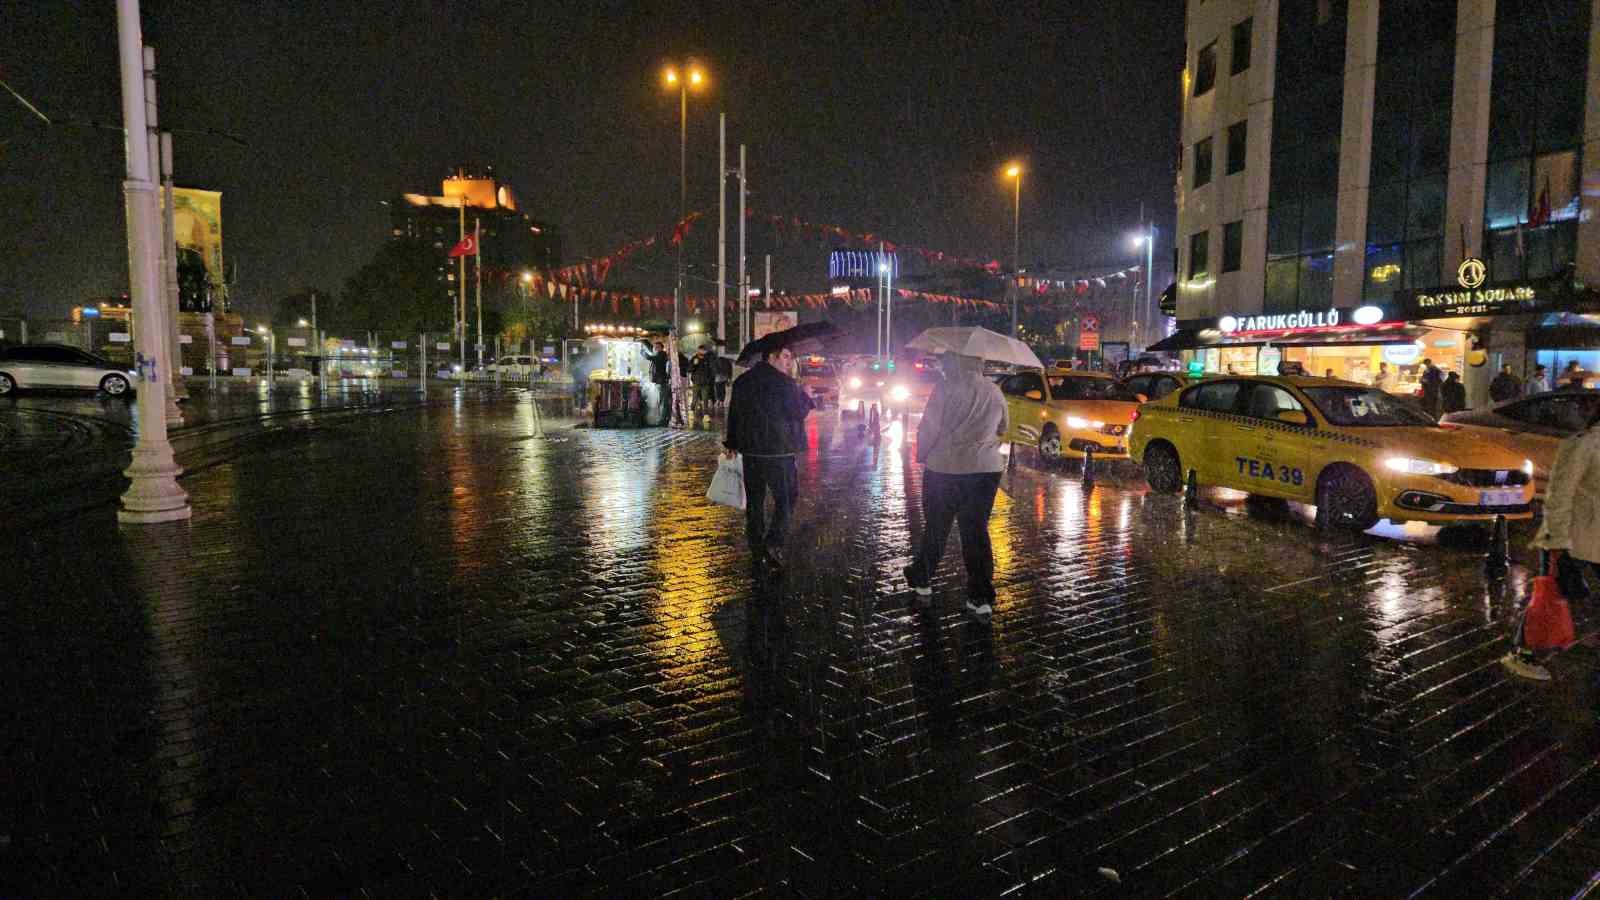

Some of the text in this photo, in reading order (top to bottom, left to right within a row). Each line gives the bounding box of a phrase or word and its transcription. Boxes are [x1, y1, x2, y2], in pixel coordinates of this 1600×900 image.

[1475, 287, 1536, 303] SQUARE
[1456, 305, 1488, 314] HOTEL
[1235, 456, 1304, 486] TEA 39
